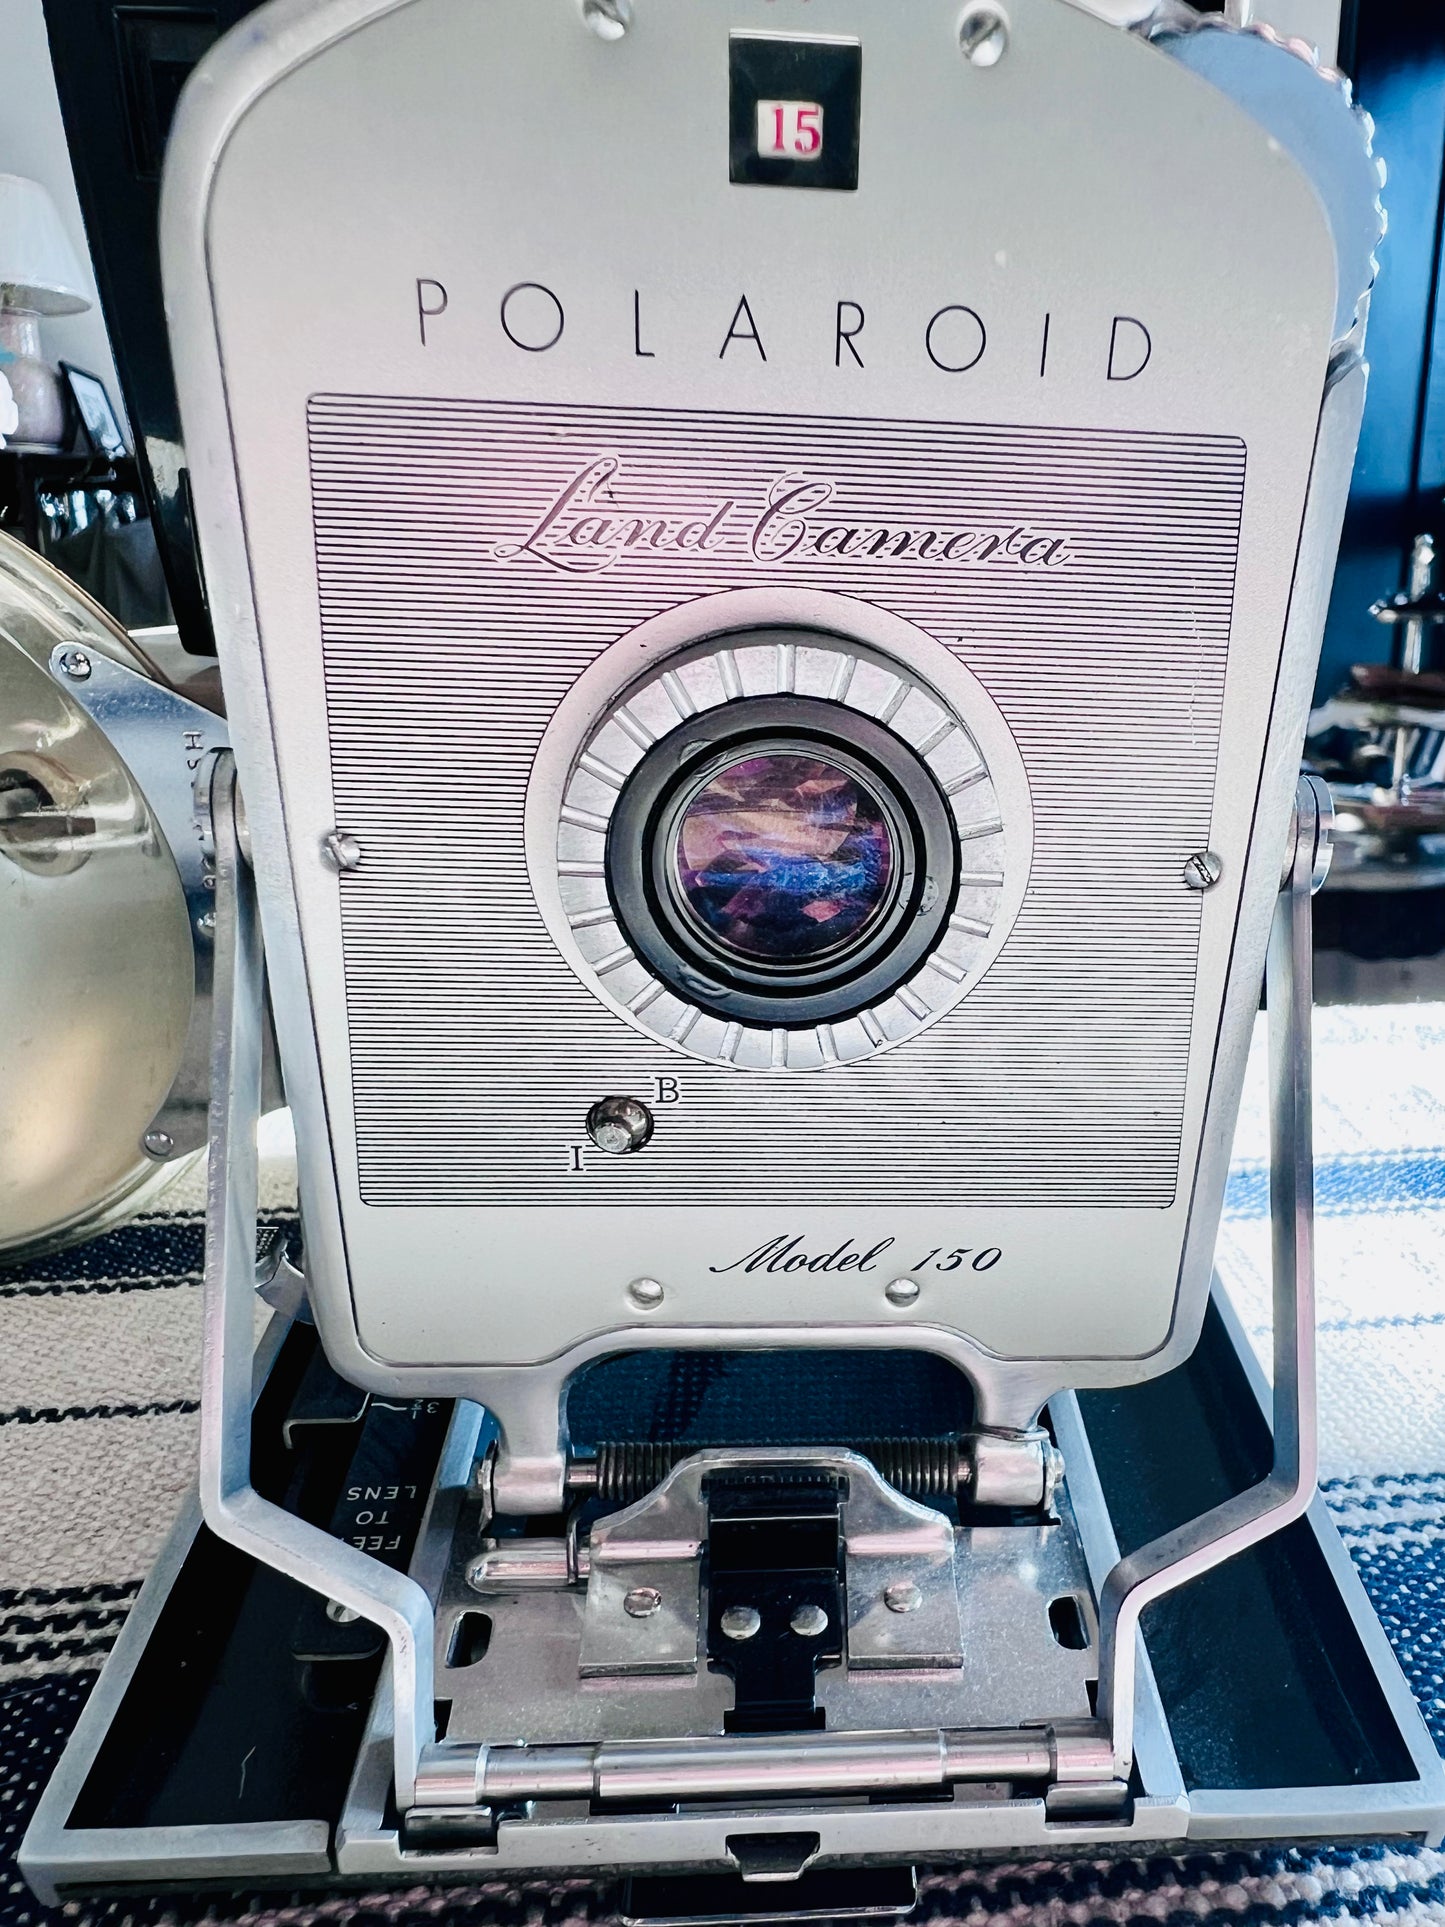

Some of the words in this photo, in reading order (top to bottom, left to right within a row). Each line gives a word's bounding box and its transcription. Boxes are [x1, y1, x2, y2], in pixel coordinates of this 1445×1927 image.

[771, 104, 821, 154] 15
[415, 278, 1152, 381] POLAROID
[493, 456, 734, 574] Land
[751, 471, 1073, 568] Camera
[655, 1077, 680, 1103] B
[571, 1146, 583, 1172] I
[709, 1234, 895, 1274] Model
[911, 1247, 1003, 1272] 150
[346, 1485, 417, 1501] LENS
[355, 1510, 389, 1525] TO
[341, 1535, 401, 1551] FEE
